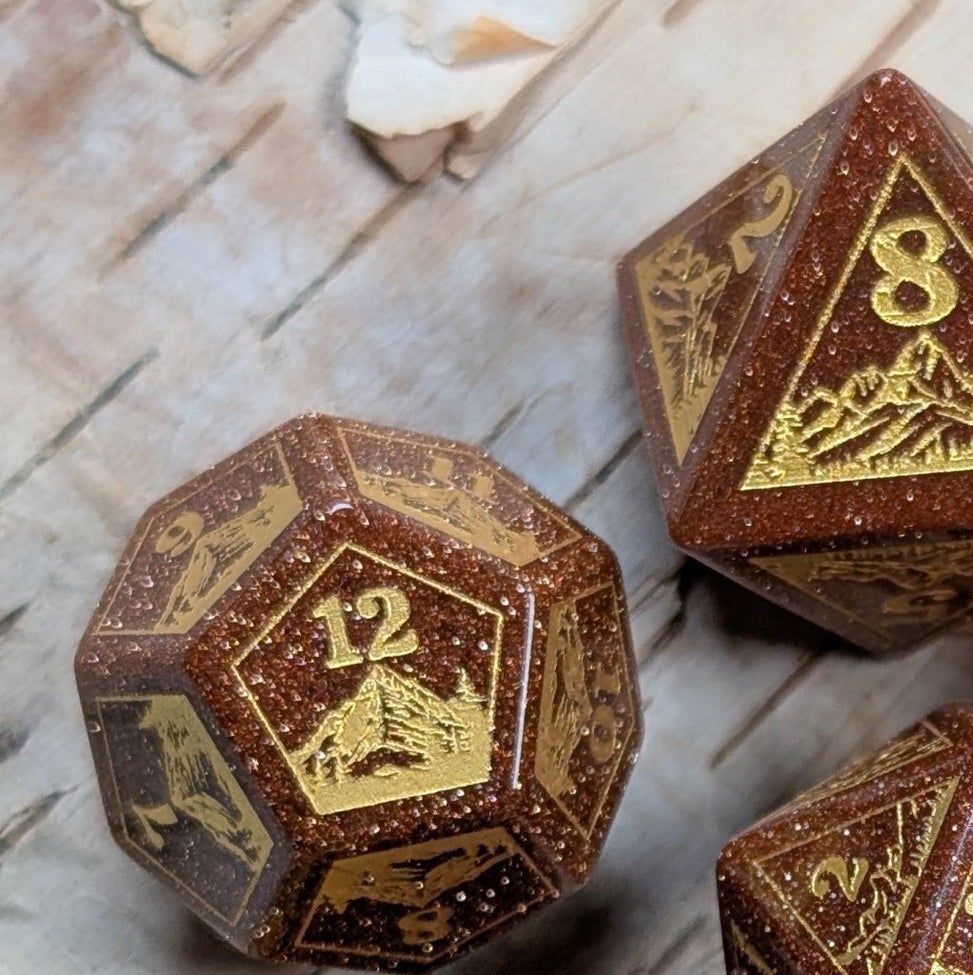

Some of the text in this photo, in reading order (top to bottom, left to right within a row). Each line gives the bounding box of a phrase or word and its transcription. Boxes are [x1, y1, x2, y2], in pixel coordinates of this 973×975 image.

[725, 173, 793, 275] 2
[870, 215, 959, 327] 8
[311, 587, 420, 670] 12
[590, 660, 622, 764] 10
[130, 799, 179, 850] 7
[810, 855, 870, 902] 2
[397, 904, 455, 946] 8
